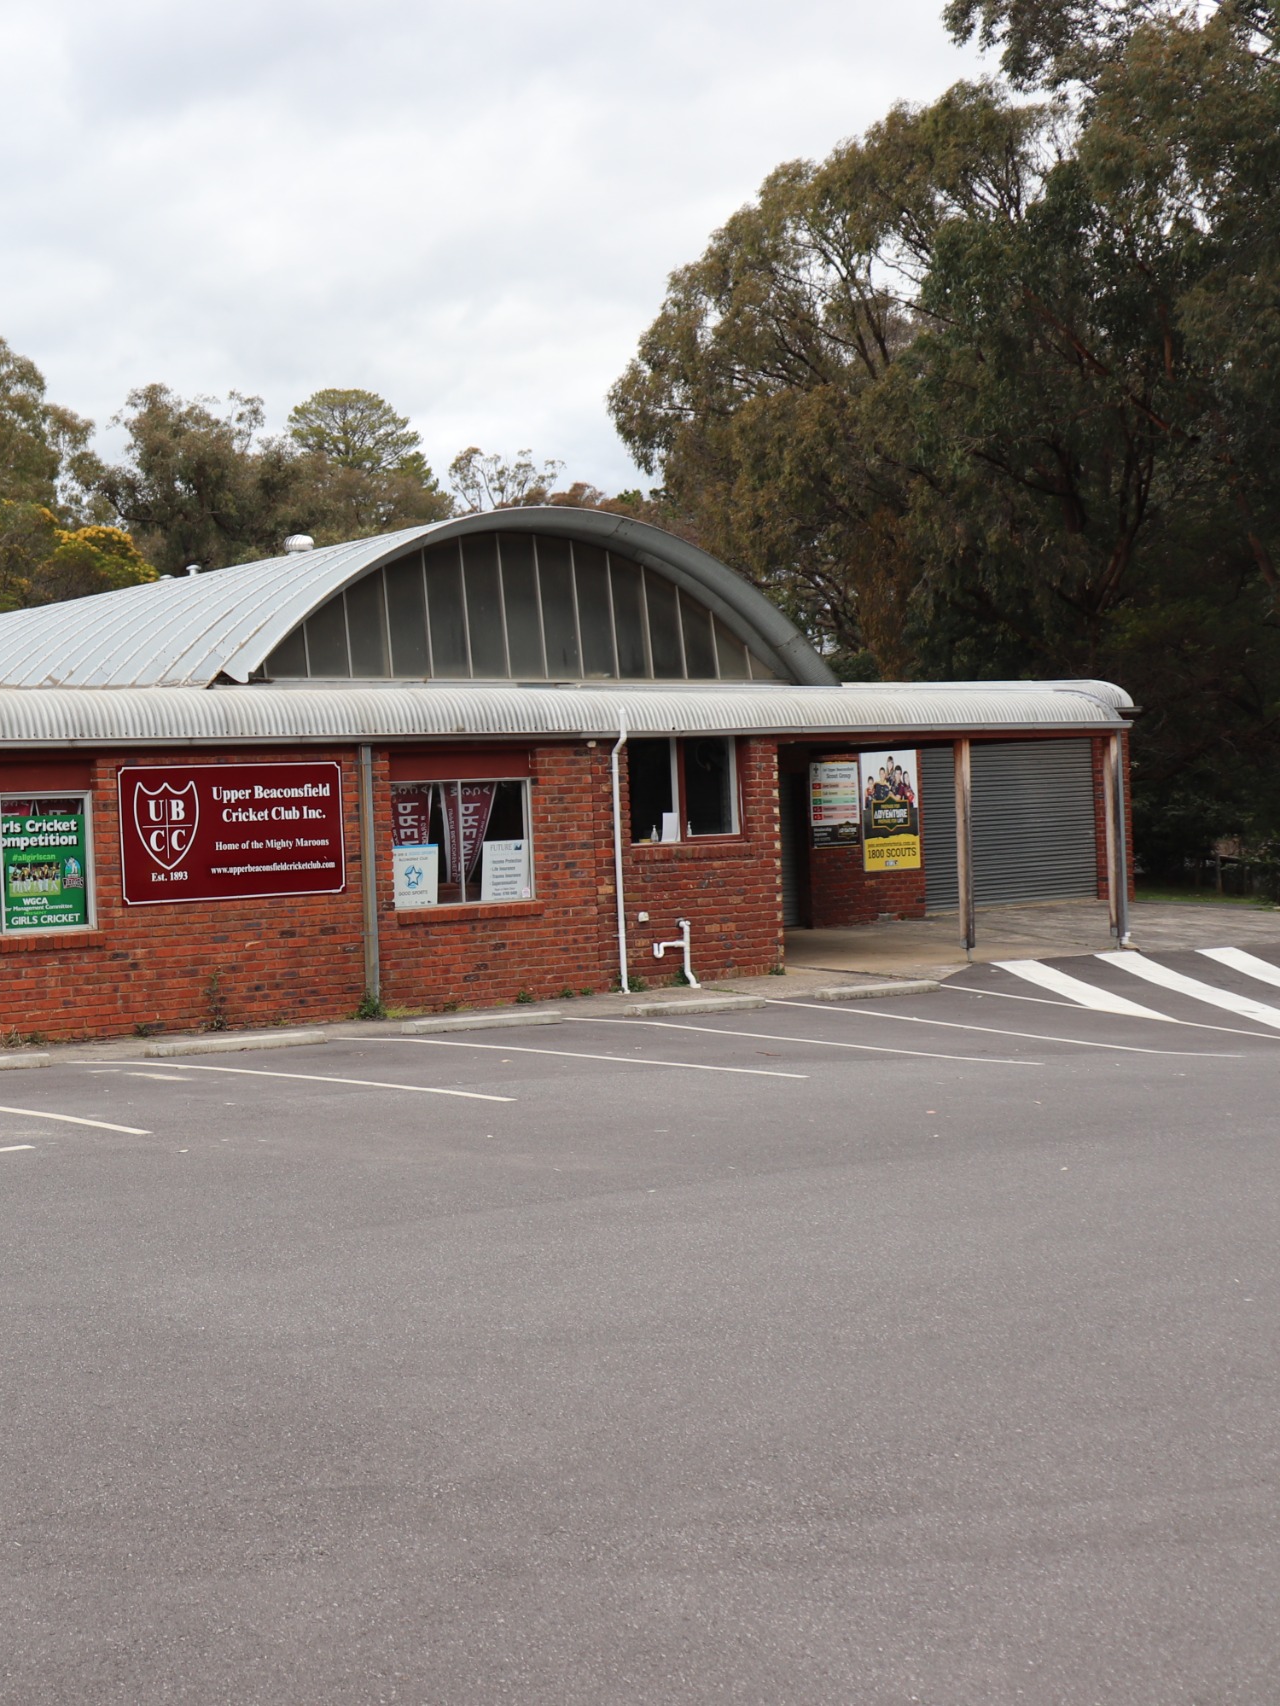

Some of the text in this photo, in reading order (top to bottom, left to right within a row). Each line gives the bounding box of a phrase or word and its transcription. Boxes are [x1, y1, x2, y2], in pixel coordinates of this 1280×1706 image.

[212, 784, 330, 803] Upper Beaconsfield
[148, 800, 185, 821] U B
[222, 806, 326, 822] Cricket Club Inc.
[874, 809, 908, 819] ADVENTURE
[26, 820, 77, 832] Cricket
[150, 829, 186, 851] C C
[216, 838, 329, 850] Home of the Mighty Maroons
[12, 854, 56, 862] #allgirlscan
[868, 847, 916, 859] 1800 SCOUTS
[211, 861, 335, 875] www.upperbeaconsfieldcricketclub.com
[152, 871, 188, 882] Est. 1893
[23, 897, 48, 905] WGCA
[11, 916, 38, 926] GIRLS
[41, 913, 80, 924] CRICKET
